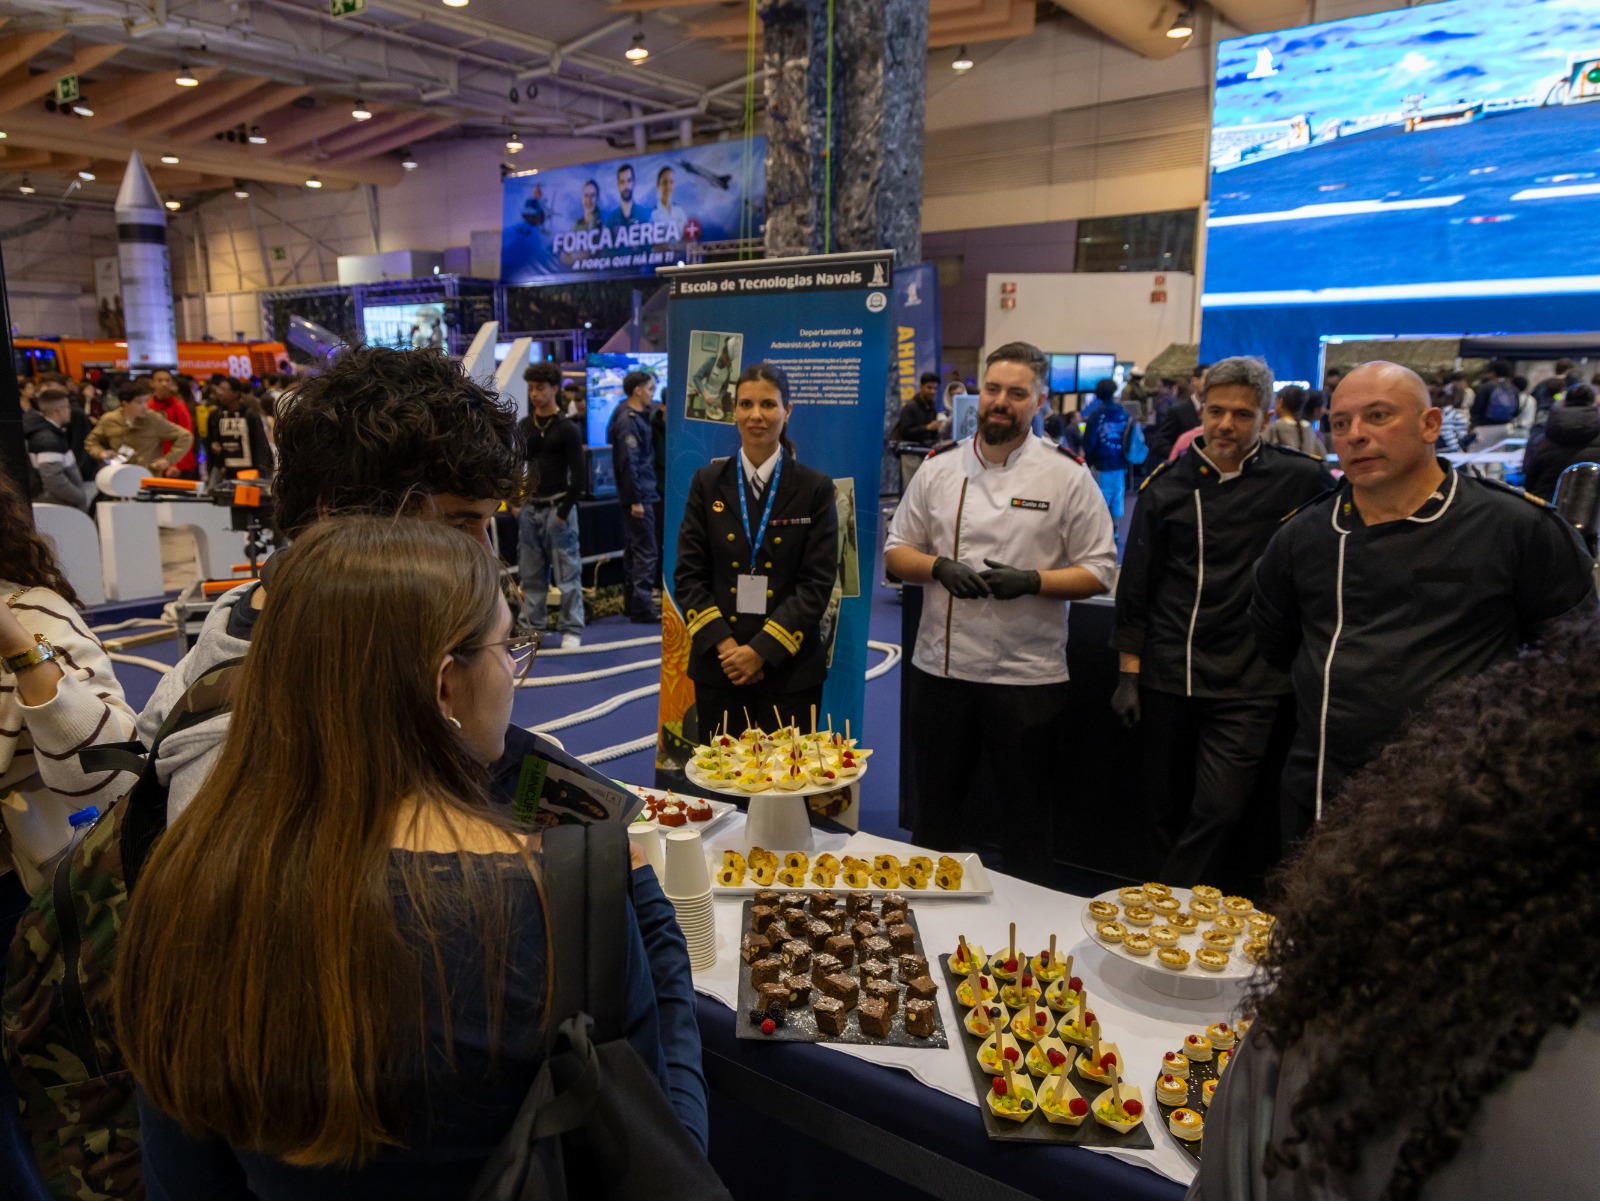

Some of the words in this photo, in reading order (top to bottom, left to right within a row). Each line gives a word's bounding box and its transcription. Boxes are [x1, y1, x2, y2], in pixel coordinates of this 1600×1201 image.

[552, 228, 612, 254] FORÇA
[615, 220, 680, 248] AÉREA
[572, 258, 582, 270] A
[582, 256, 611, 270] FORÇA
[612, 254, 632, 268] QUE
[632, 250, 648, 266] HÁ
[648, 252, 663, 264] EM
[680, 279, 718, 294] Escola
[720, 277, 736, 292] de
[738, 274, 812, 291] Tecnologias
[816, 270, 862, 286] Navais
[800, 328, 851, 338] Departamento
[770, 341, 820, 350] Administração
[828, 340, 862, 348] Logística
[227, 354, 252, 380] 88
